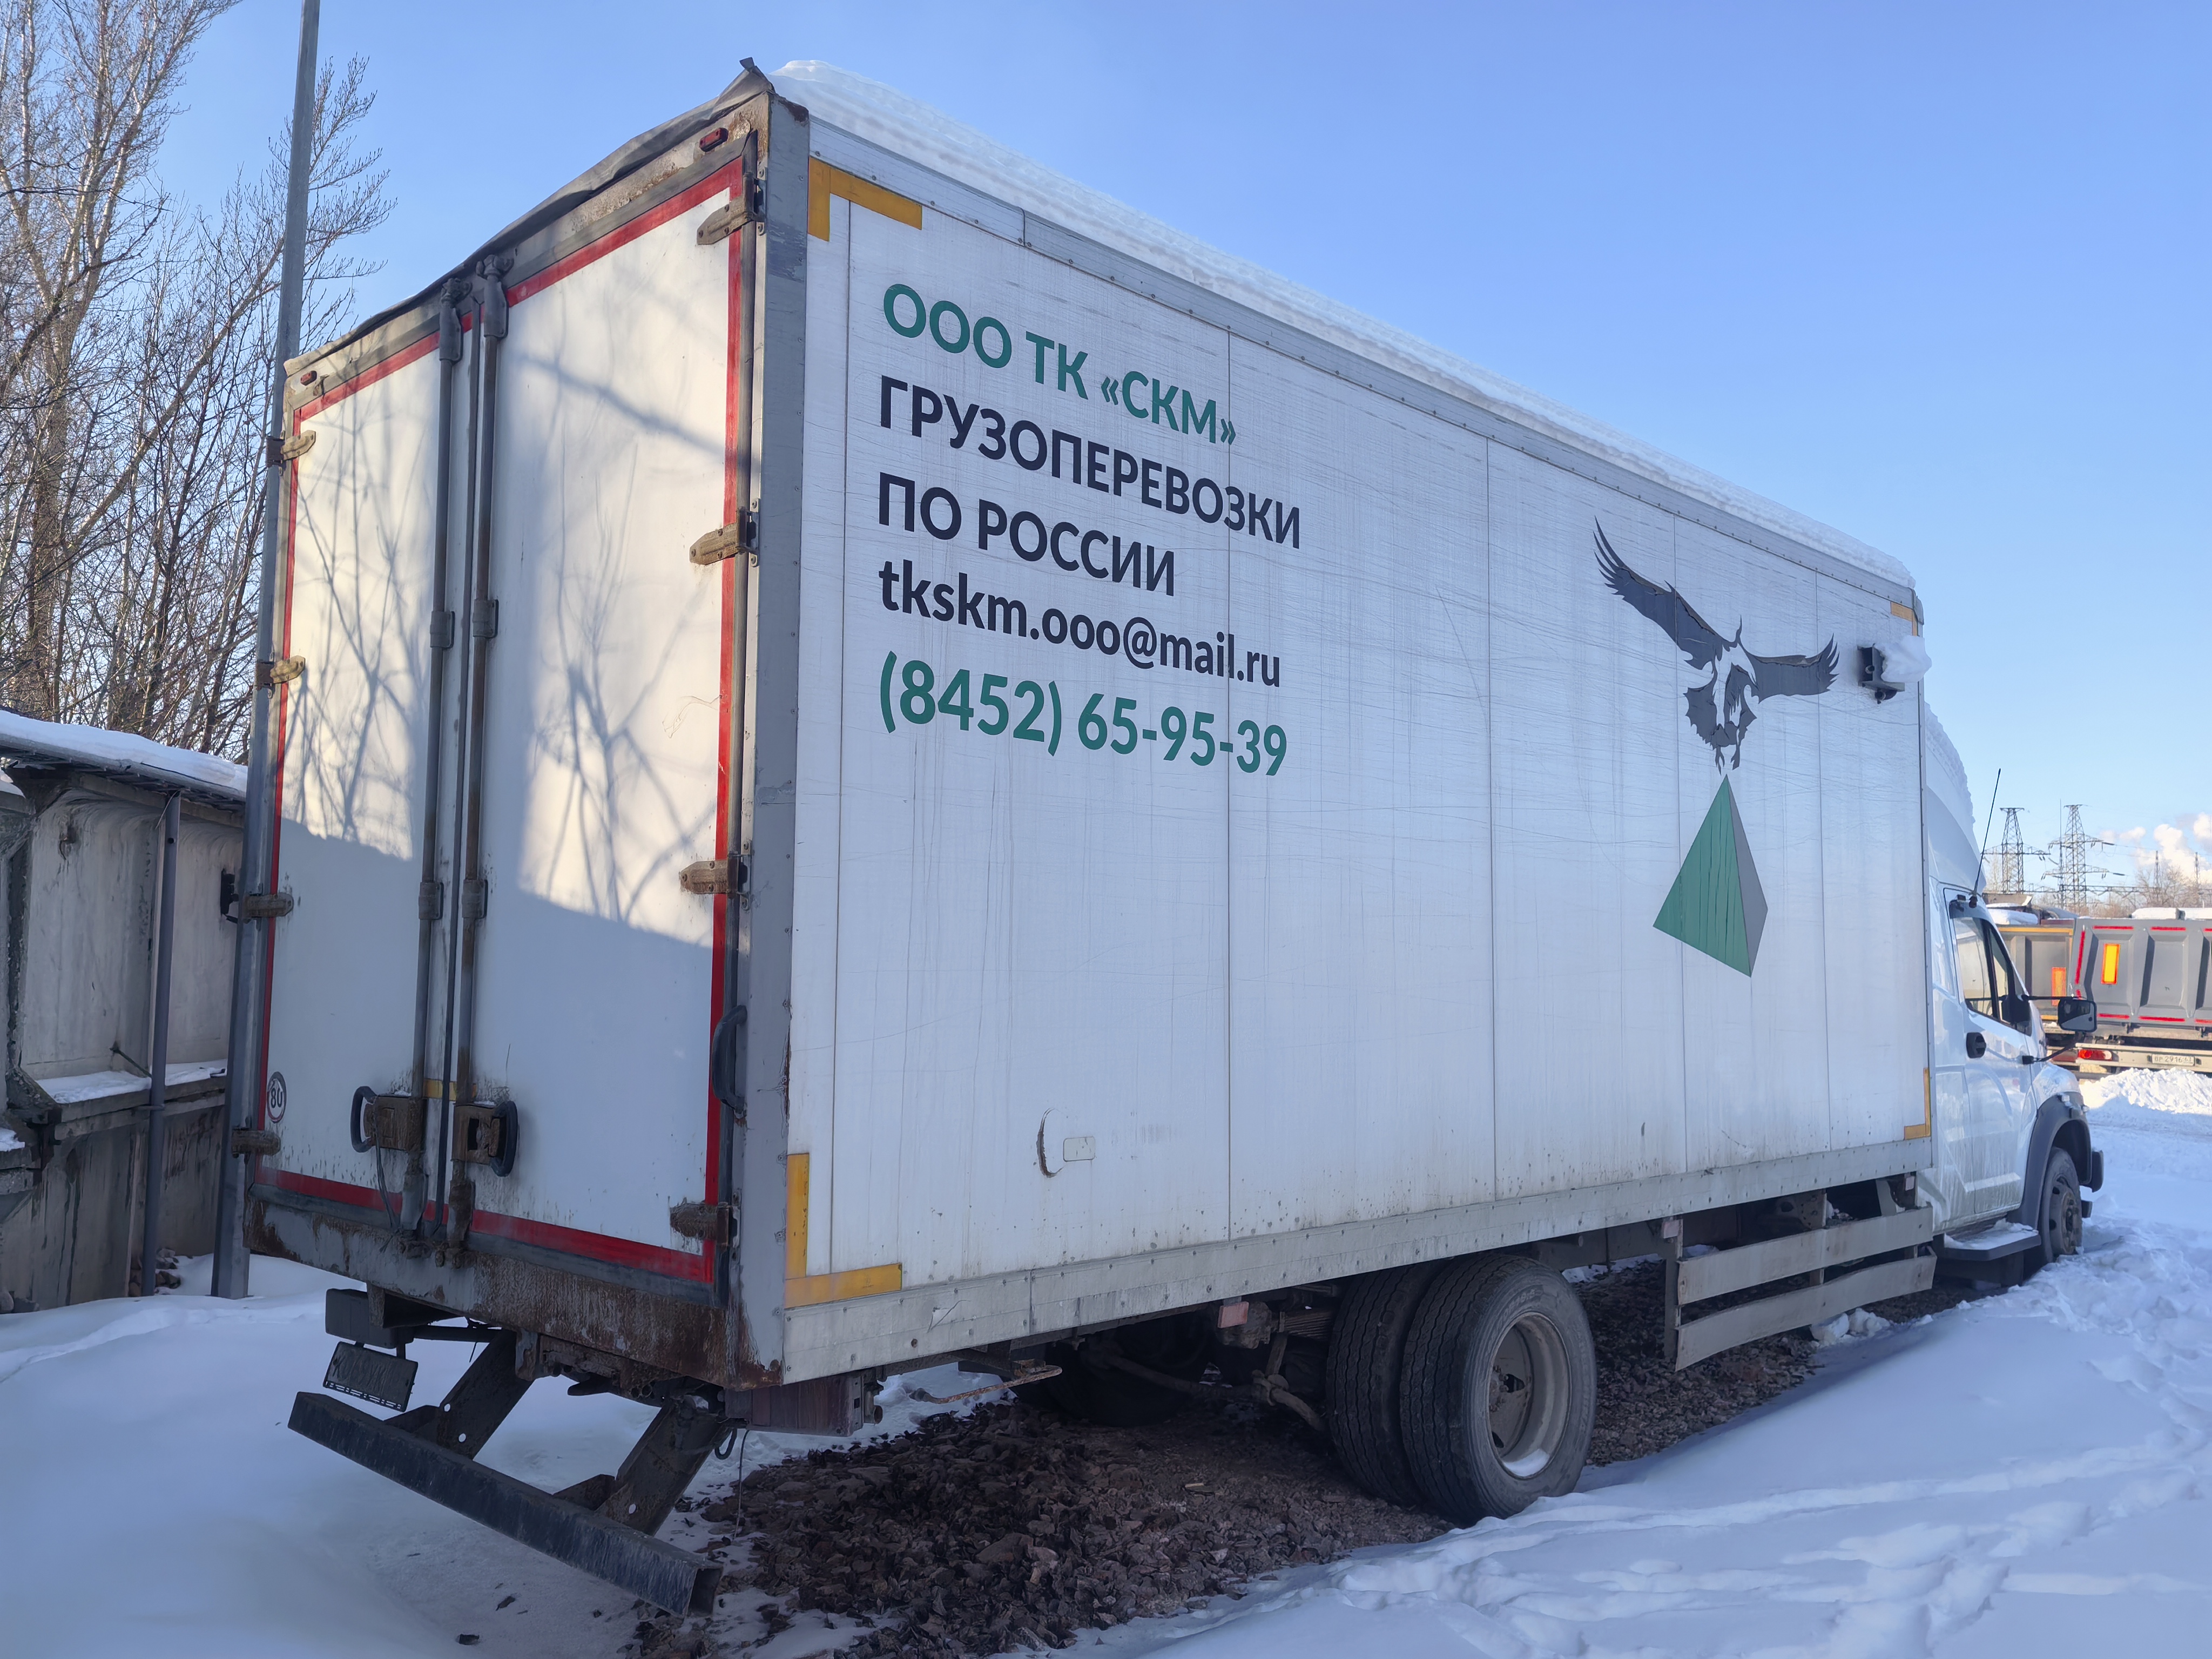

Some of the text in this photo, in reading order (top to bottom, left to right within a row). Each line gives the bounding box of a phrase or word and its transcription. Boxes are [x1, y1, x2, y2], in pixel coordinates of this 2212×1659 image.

[883, 284, 1236, 447] ООО ТК «СКМ»
[880, 375, 1299, 549] ГРУЗОПЕРЕВОЗКИ
[879, 471, 1174, 597] ПО РОССИИ
[878, 559, 1280, 687] tkskm.ooo@mail.ru
[880, 651, 1287, 776] (8452) 65-95-39
[271, 1087, 282, 1108] 80
